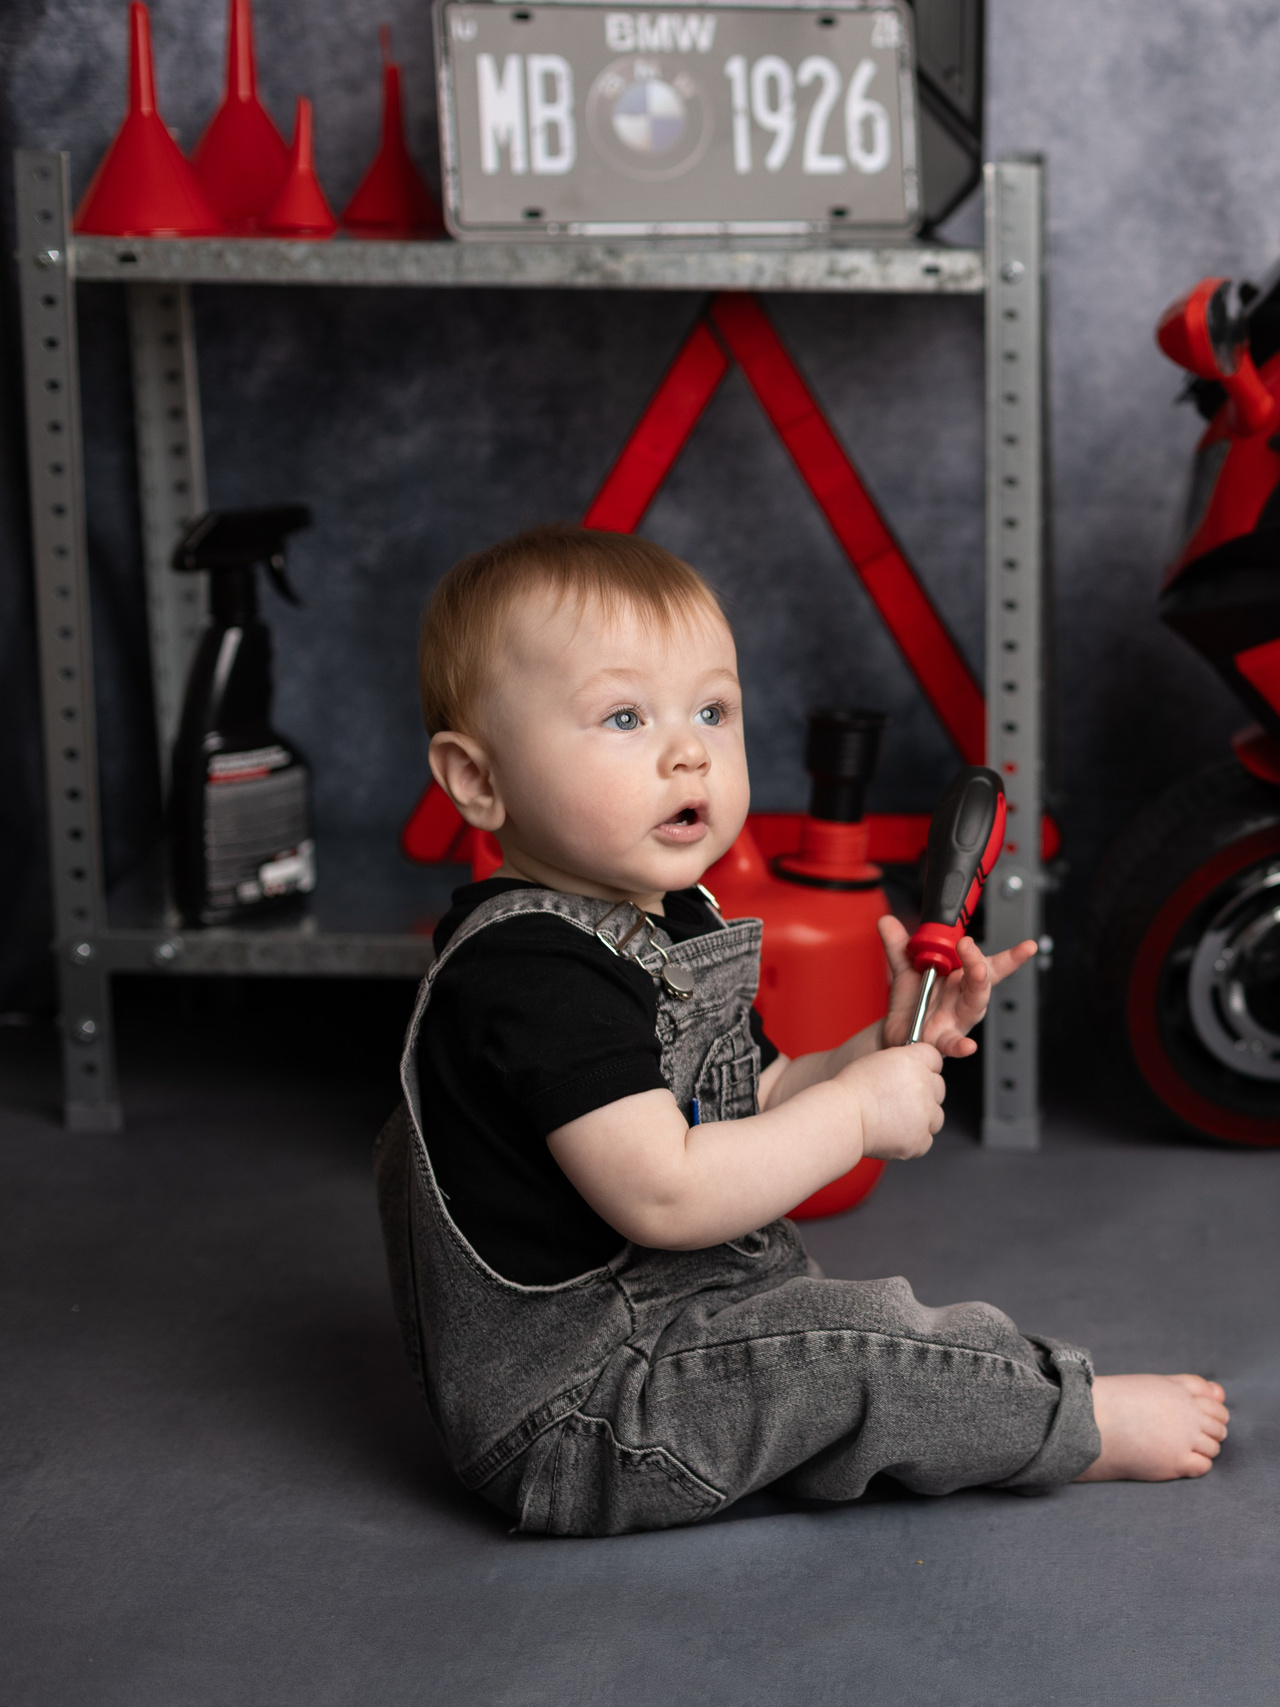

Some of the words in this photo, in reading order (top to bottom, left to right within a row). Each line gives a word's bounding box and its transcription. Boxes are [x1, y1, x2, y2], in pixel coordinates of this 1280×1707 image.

[605, 13, 716, 52] BMW
[475, 53, 577, 176] MB
[724, 55, 891, 175] 1926
